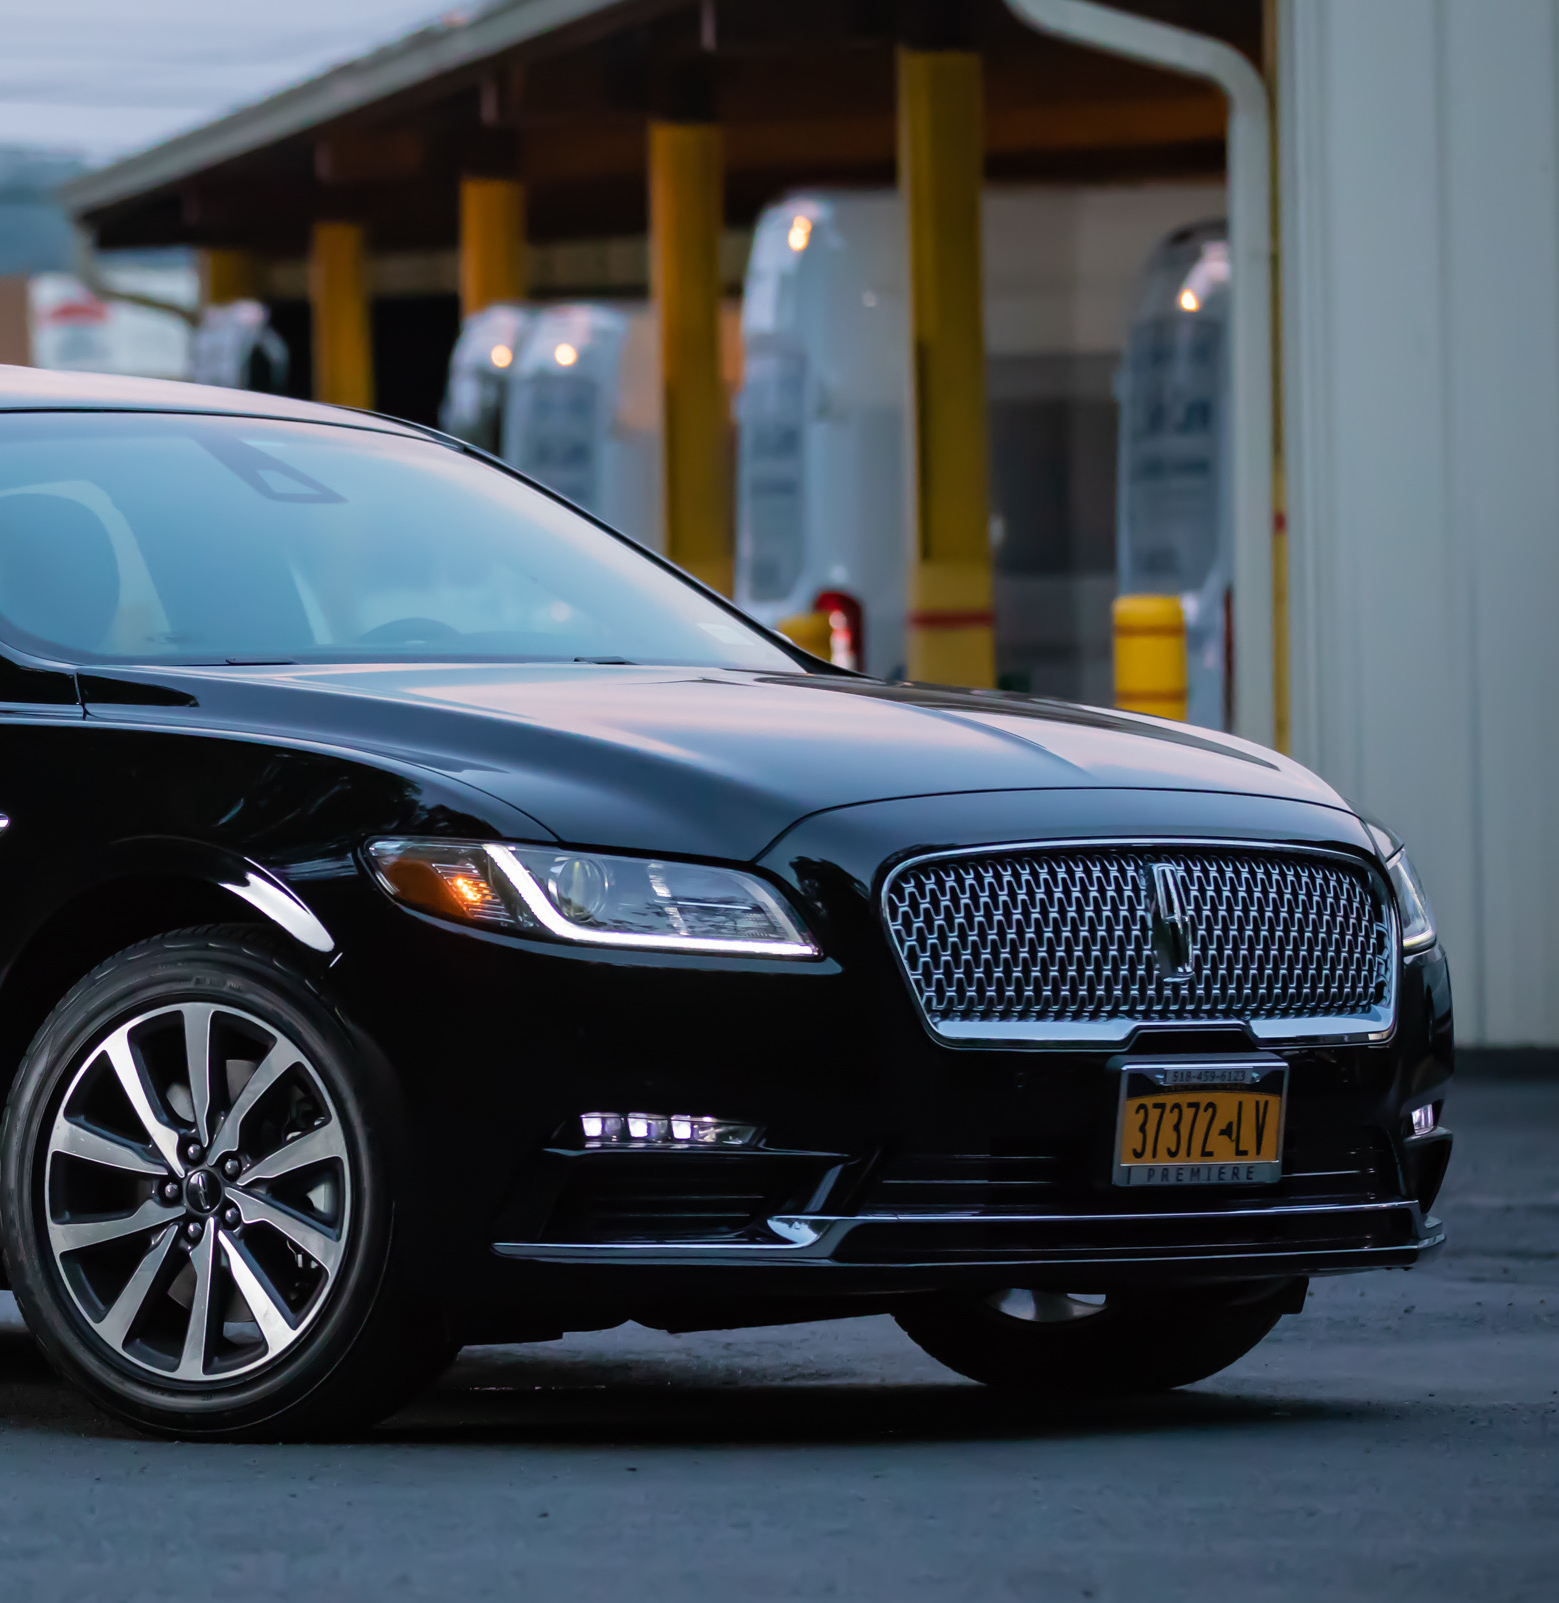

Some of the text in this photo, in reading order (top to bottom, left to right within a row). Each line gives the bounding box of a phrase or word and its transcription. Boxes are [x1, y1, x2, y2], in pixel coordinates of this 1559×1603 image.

[1172, 1069, 1246, 1083] 518-459-6123
[1132, 1100, 1269, 1159] 37372 LV
[1147, 1166, 1255, 1182] PREMIERE
